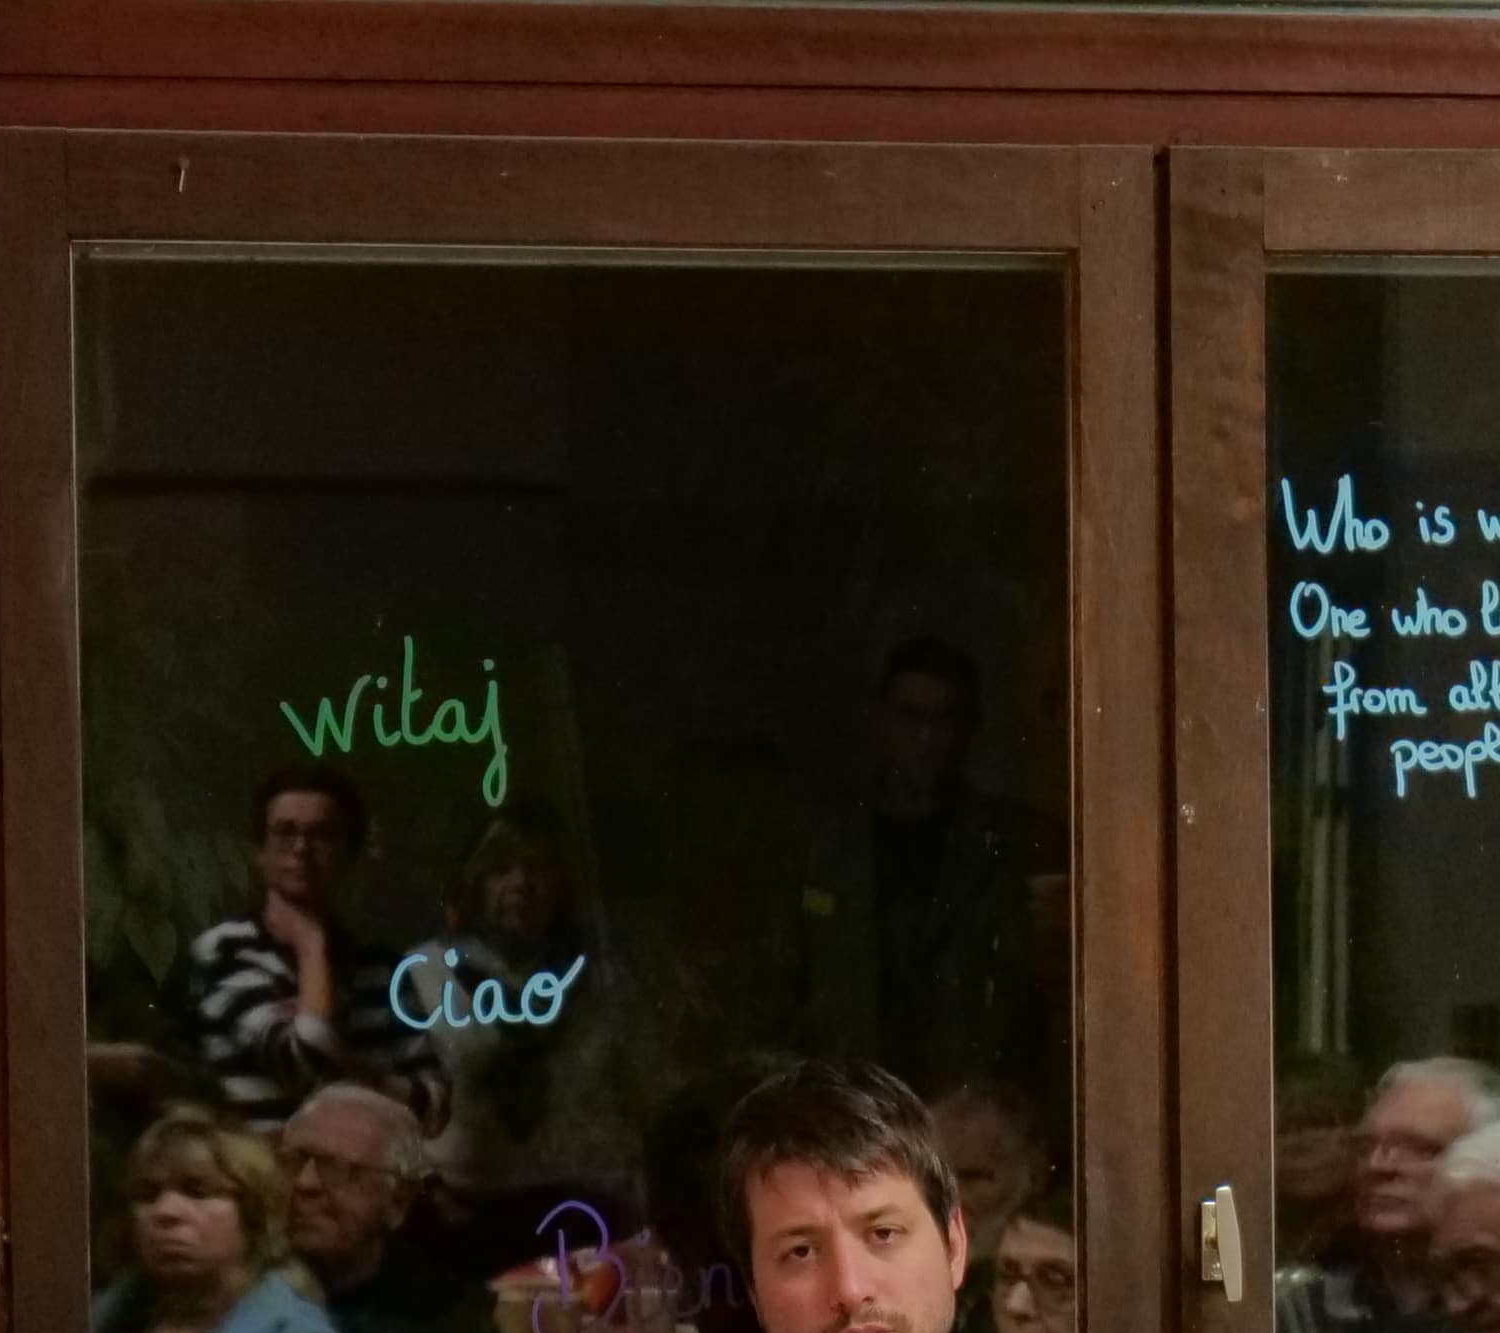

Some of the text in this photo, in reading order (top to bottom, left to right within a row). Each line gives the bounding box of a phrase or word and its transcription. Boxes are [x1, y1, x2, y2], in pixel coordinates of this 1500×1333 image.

[1281, 472, 1391, 555] Who
[1416, 500, 1457, 546] is
[1289, 581, 1371, 639] One
[1391, 588, 1468, 637] who
[1323, 660, 1427, 741] from
[388, 946, 586, 1030] Ciao
